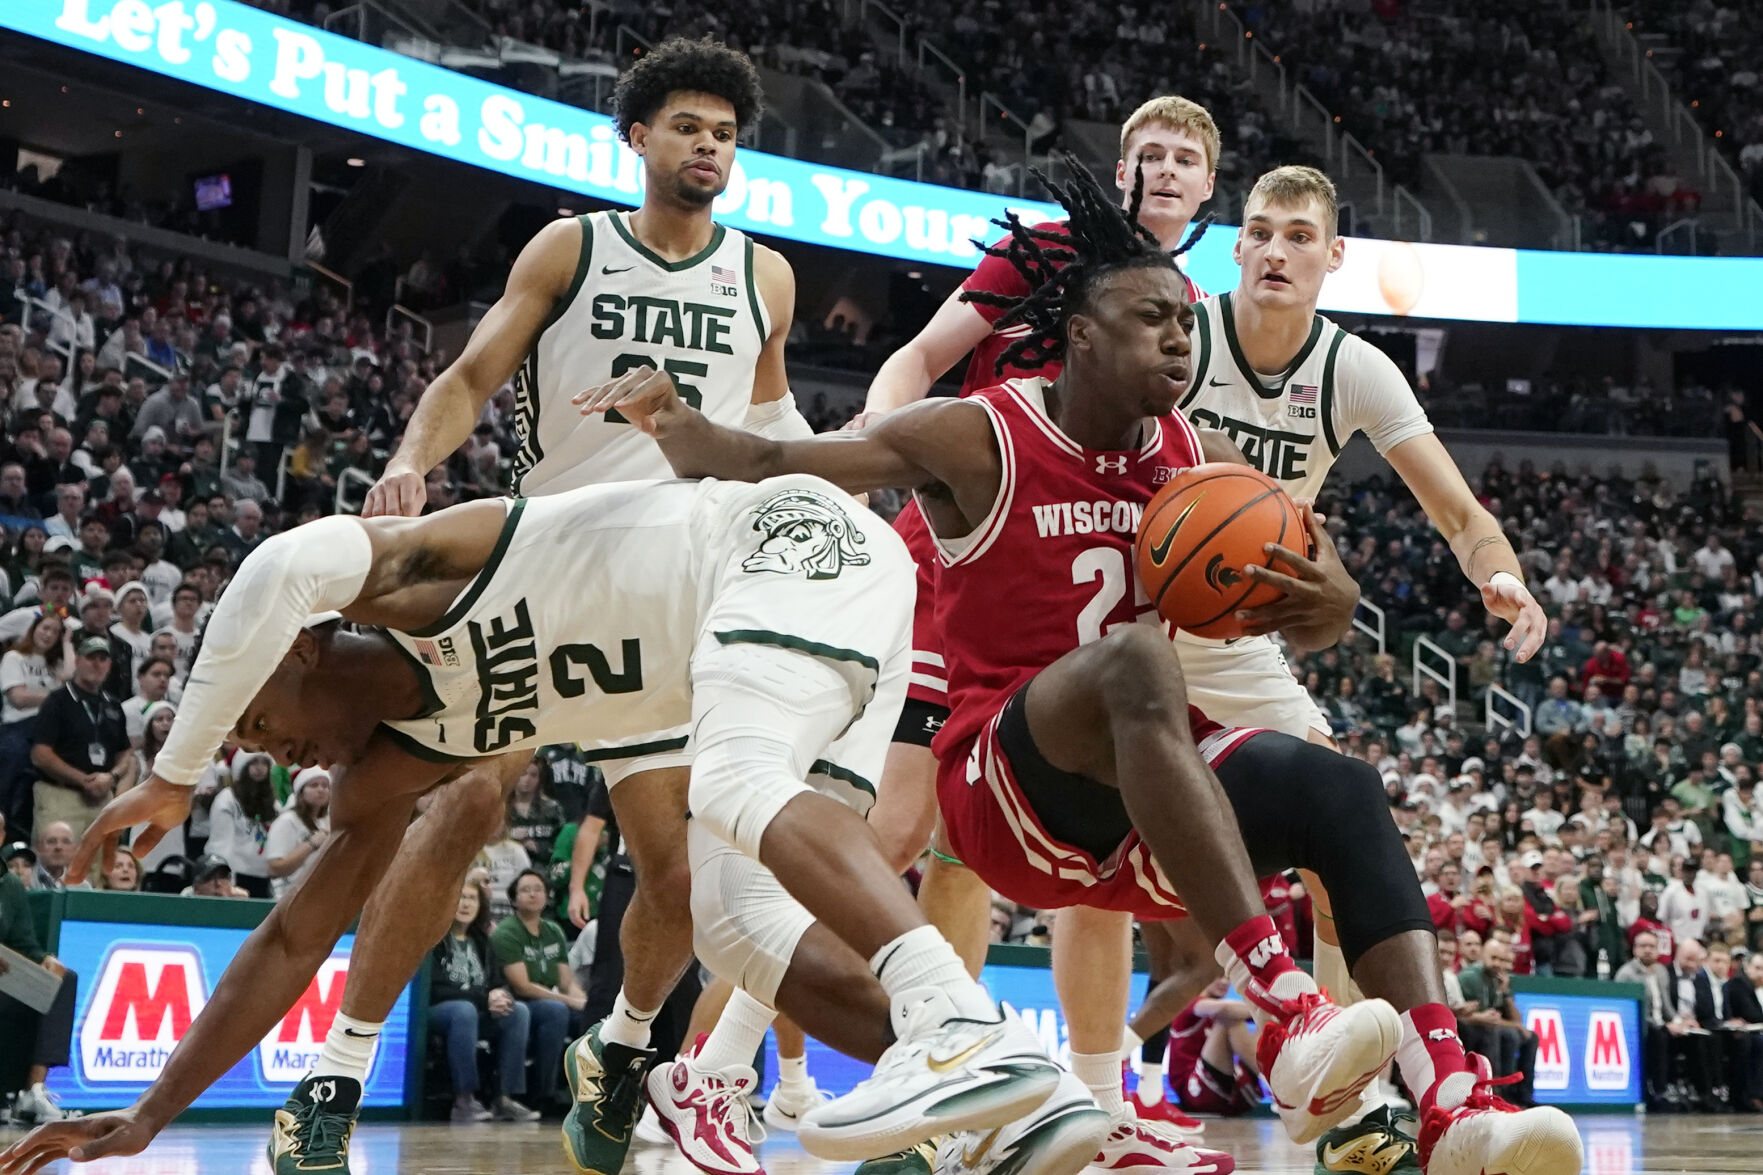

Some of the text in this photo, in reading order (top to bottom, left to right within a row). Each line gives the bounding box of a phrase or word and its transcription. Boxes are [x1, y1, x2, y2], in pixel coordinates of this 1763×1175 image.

[55, 0, 252, 83] Let's
[269, 27, 407, 129] Put
[419, 94, 461, 146] a
[477, 94, 647, 194] Smil
[811, 173, 988, 257] Your
[591, 293, 737, 355] STATE
[467, 597, 539, 753] STATE
[549, 638, 643, 698] 2
[100, 962, 193, 1041] M
[1593, 1020, 1622, 1065] M
